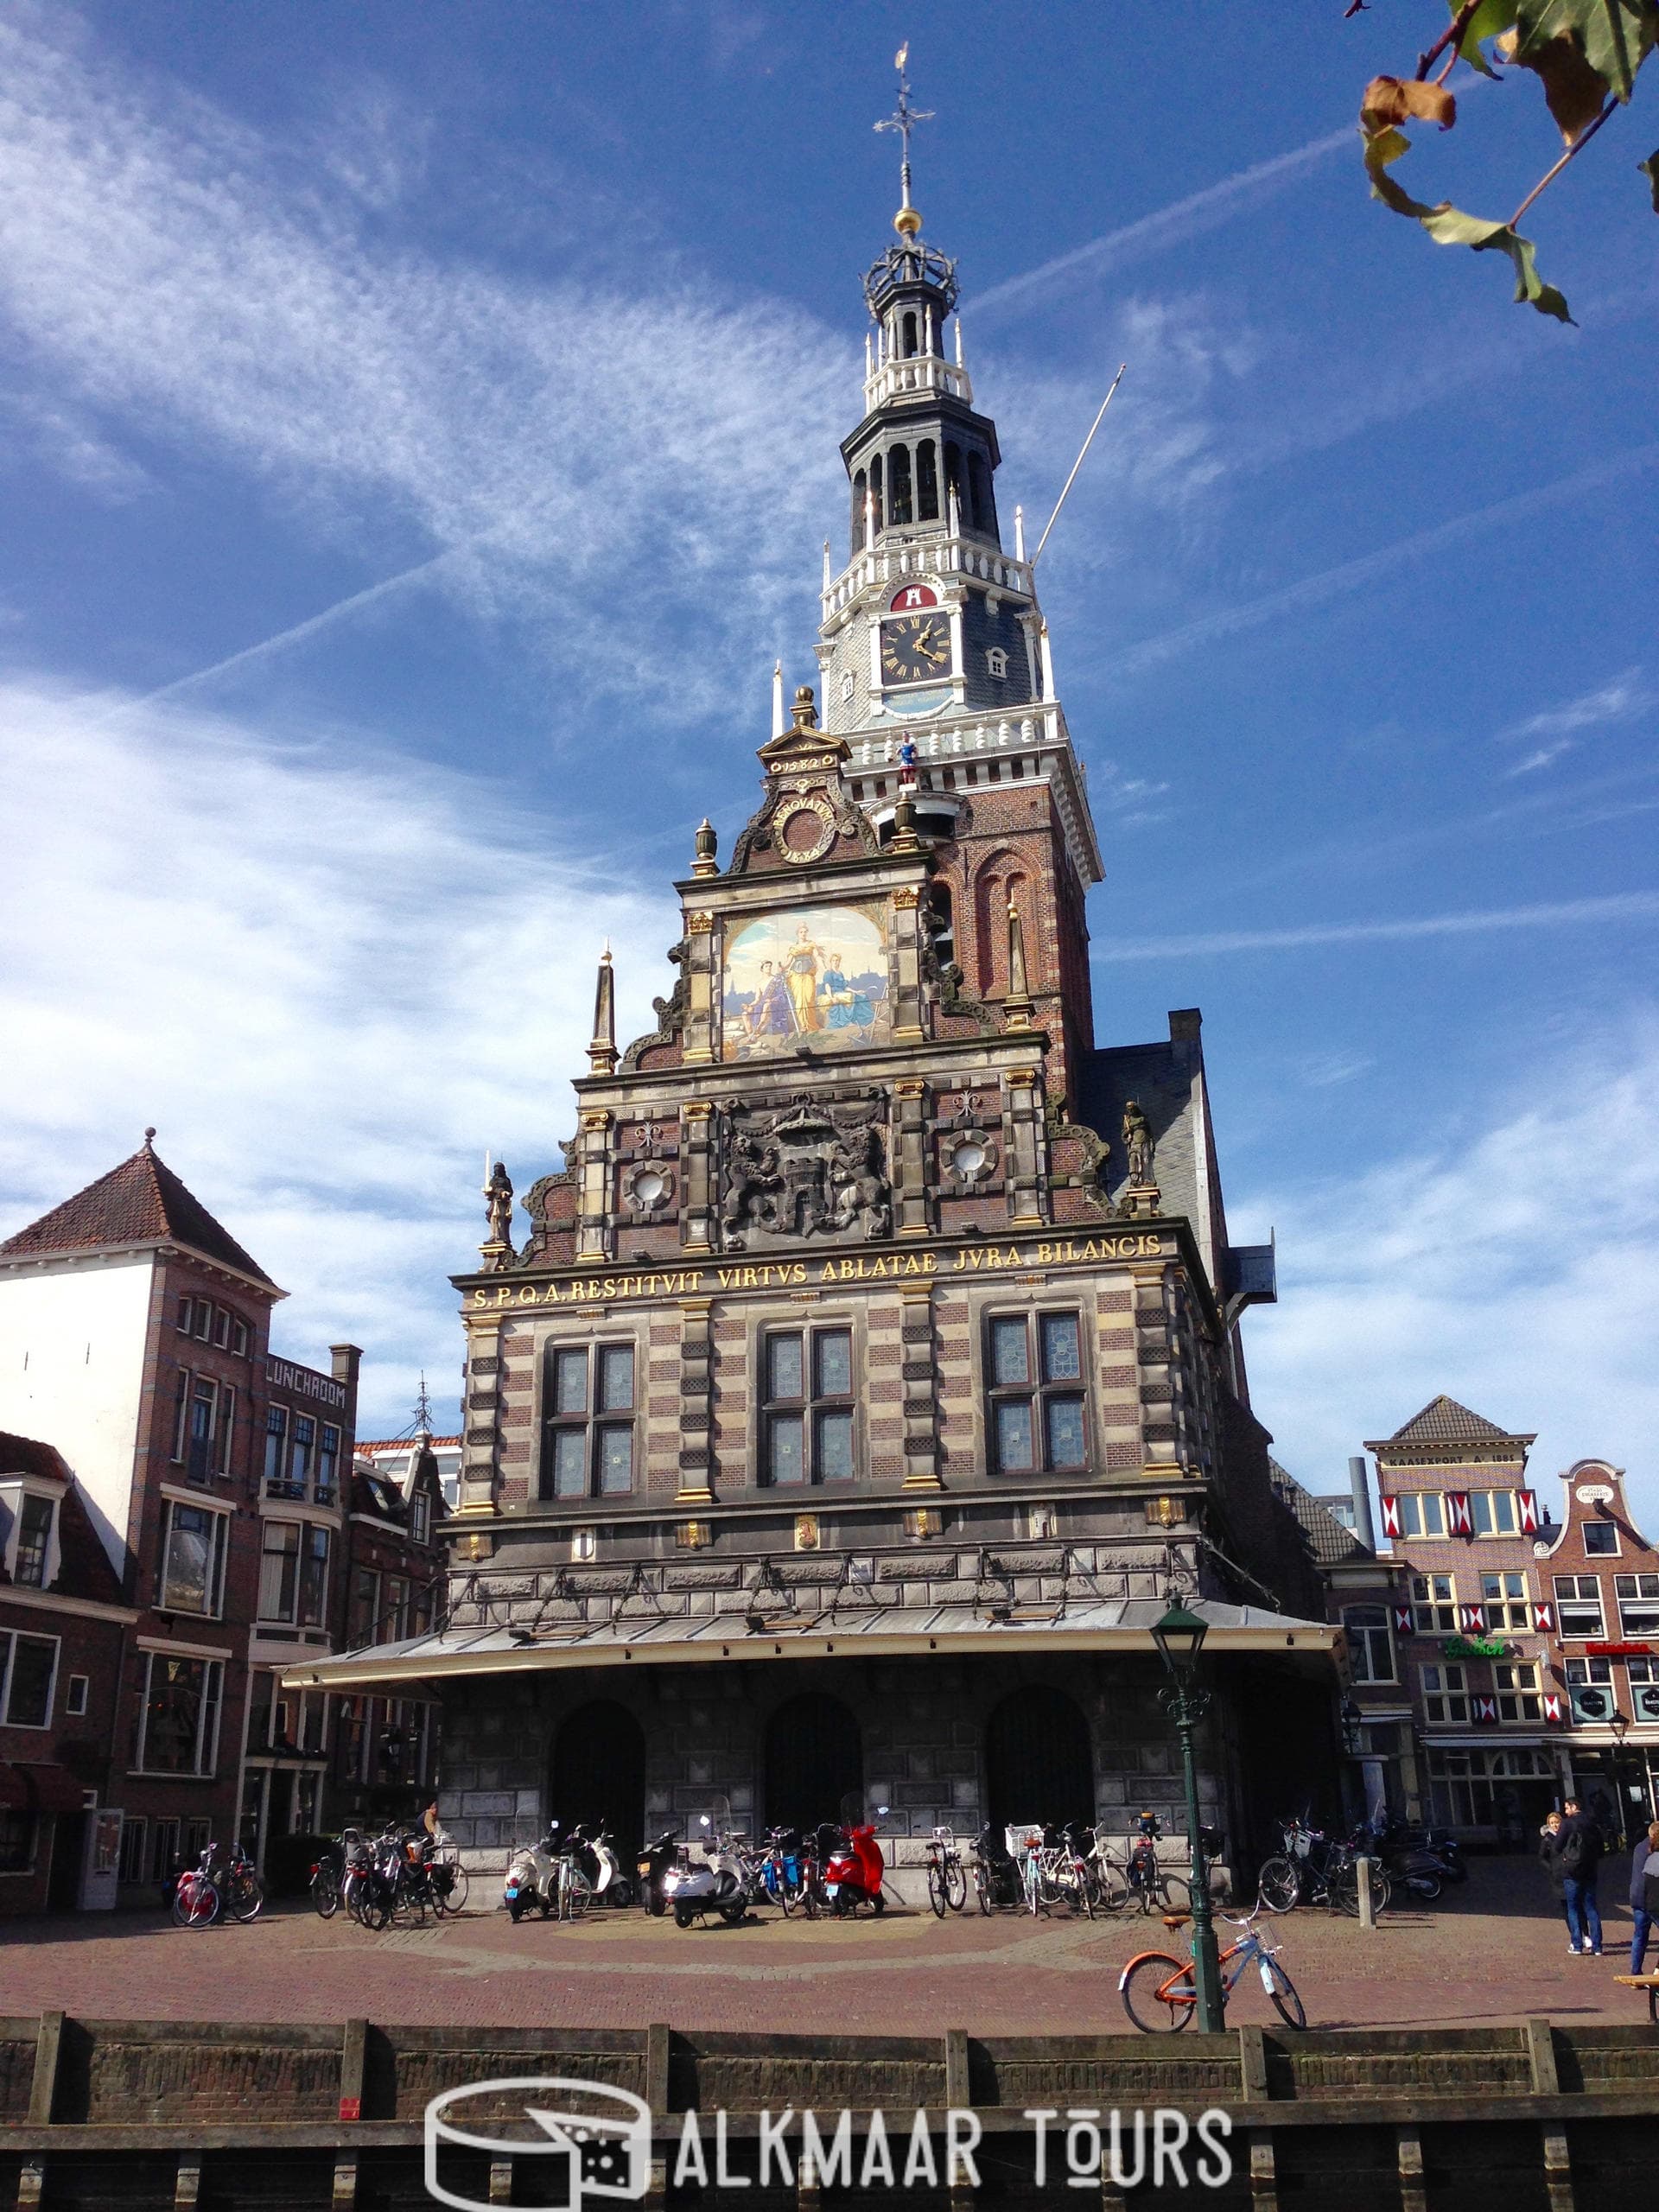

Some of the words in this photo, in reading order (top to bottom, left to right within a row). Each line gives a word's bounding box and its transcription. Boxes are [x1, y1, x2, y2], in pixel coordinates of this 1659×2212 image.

[785, 758, 819, 772] 1582
[717, 1262, 807, 1289] VIRTVS
[821, 1253, 938, 1282] ABLATAE
[953, 1247, 1023, 1272] JVRA
[1038, 1235, 1163, 1264] BILANCIS
[265, 1361, 346, 1409] LUNCHROOM
[1389, 1456, 1463, 1467] KAASEXPORT
